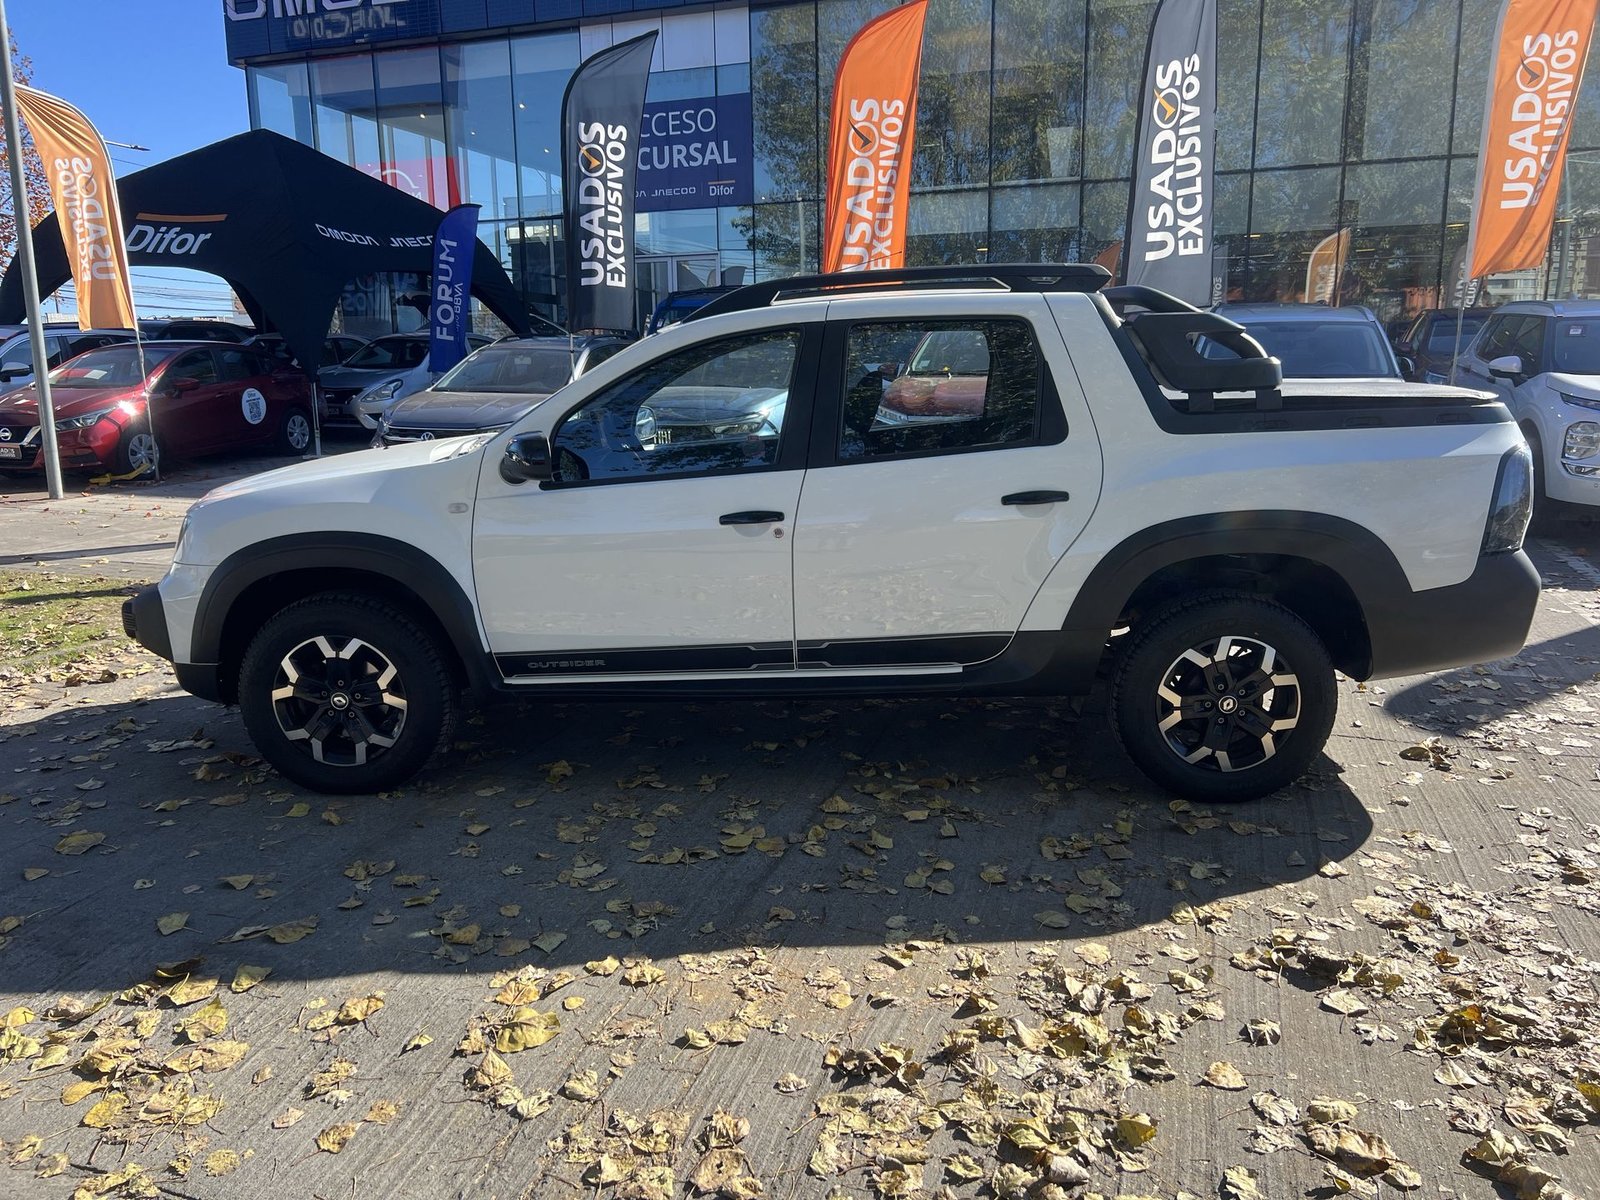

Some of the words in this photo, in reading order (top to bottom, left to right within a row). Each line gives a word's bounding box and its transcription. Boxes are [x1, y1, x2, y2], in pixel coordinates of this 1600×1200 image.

[709, 185, 735, 196] Difor
[841, 98, 880, 273] USADOS
[869, 99, 905, 271] EXCLUSIVOS
[1145, 59, 1183, 262] USADOS
[1176, 53, 1204, 256] EXCLUSIVOS
[1500, 32, 1552, 209] USADOS
[125, 224, 212, 255] Difor
[315, 223, 380, 246] OMODA
[578, 122, 606, 287] USADOS
[606, 124, 628, 288] EXCLUSIVOS
[436, 239, 458, 341] FORUM
[453, 282, 464, 315] BBVA
[527, 659, 607, 669] OUTSIDER
